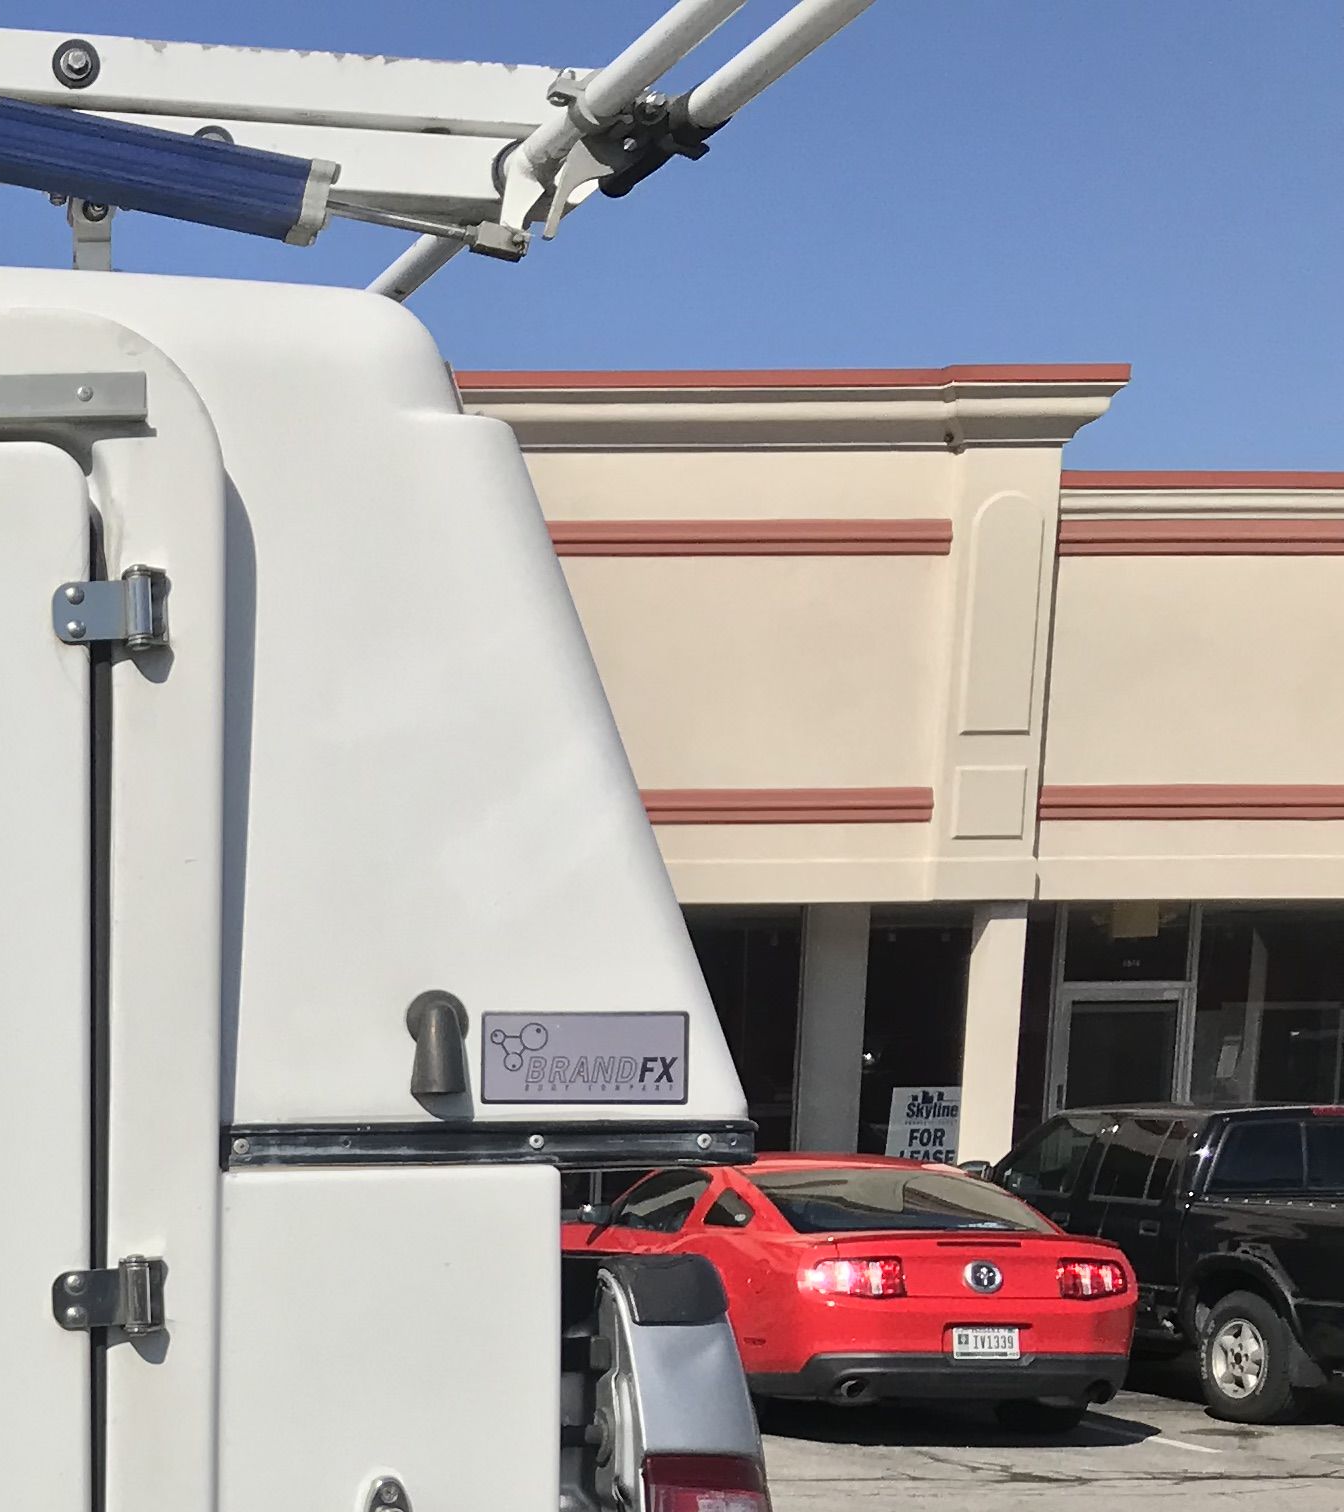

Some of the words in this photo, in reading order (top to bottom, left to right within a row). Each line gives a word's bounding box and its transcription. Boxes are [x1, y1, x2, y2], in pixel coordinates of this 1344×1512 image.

[525, 1056, 678, 1083] BRANDFX
[906, 1102, 959, 1119] Skyline
[908, 1128, 946, 1147] FOR
